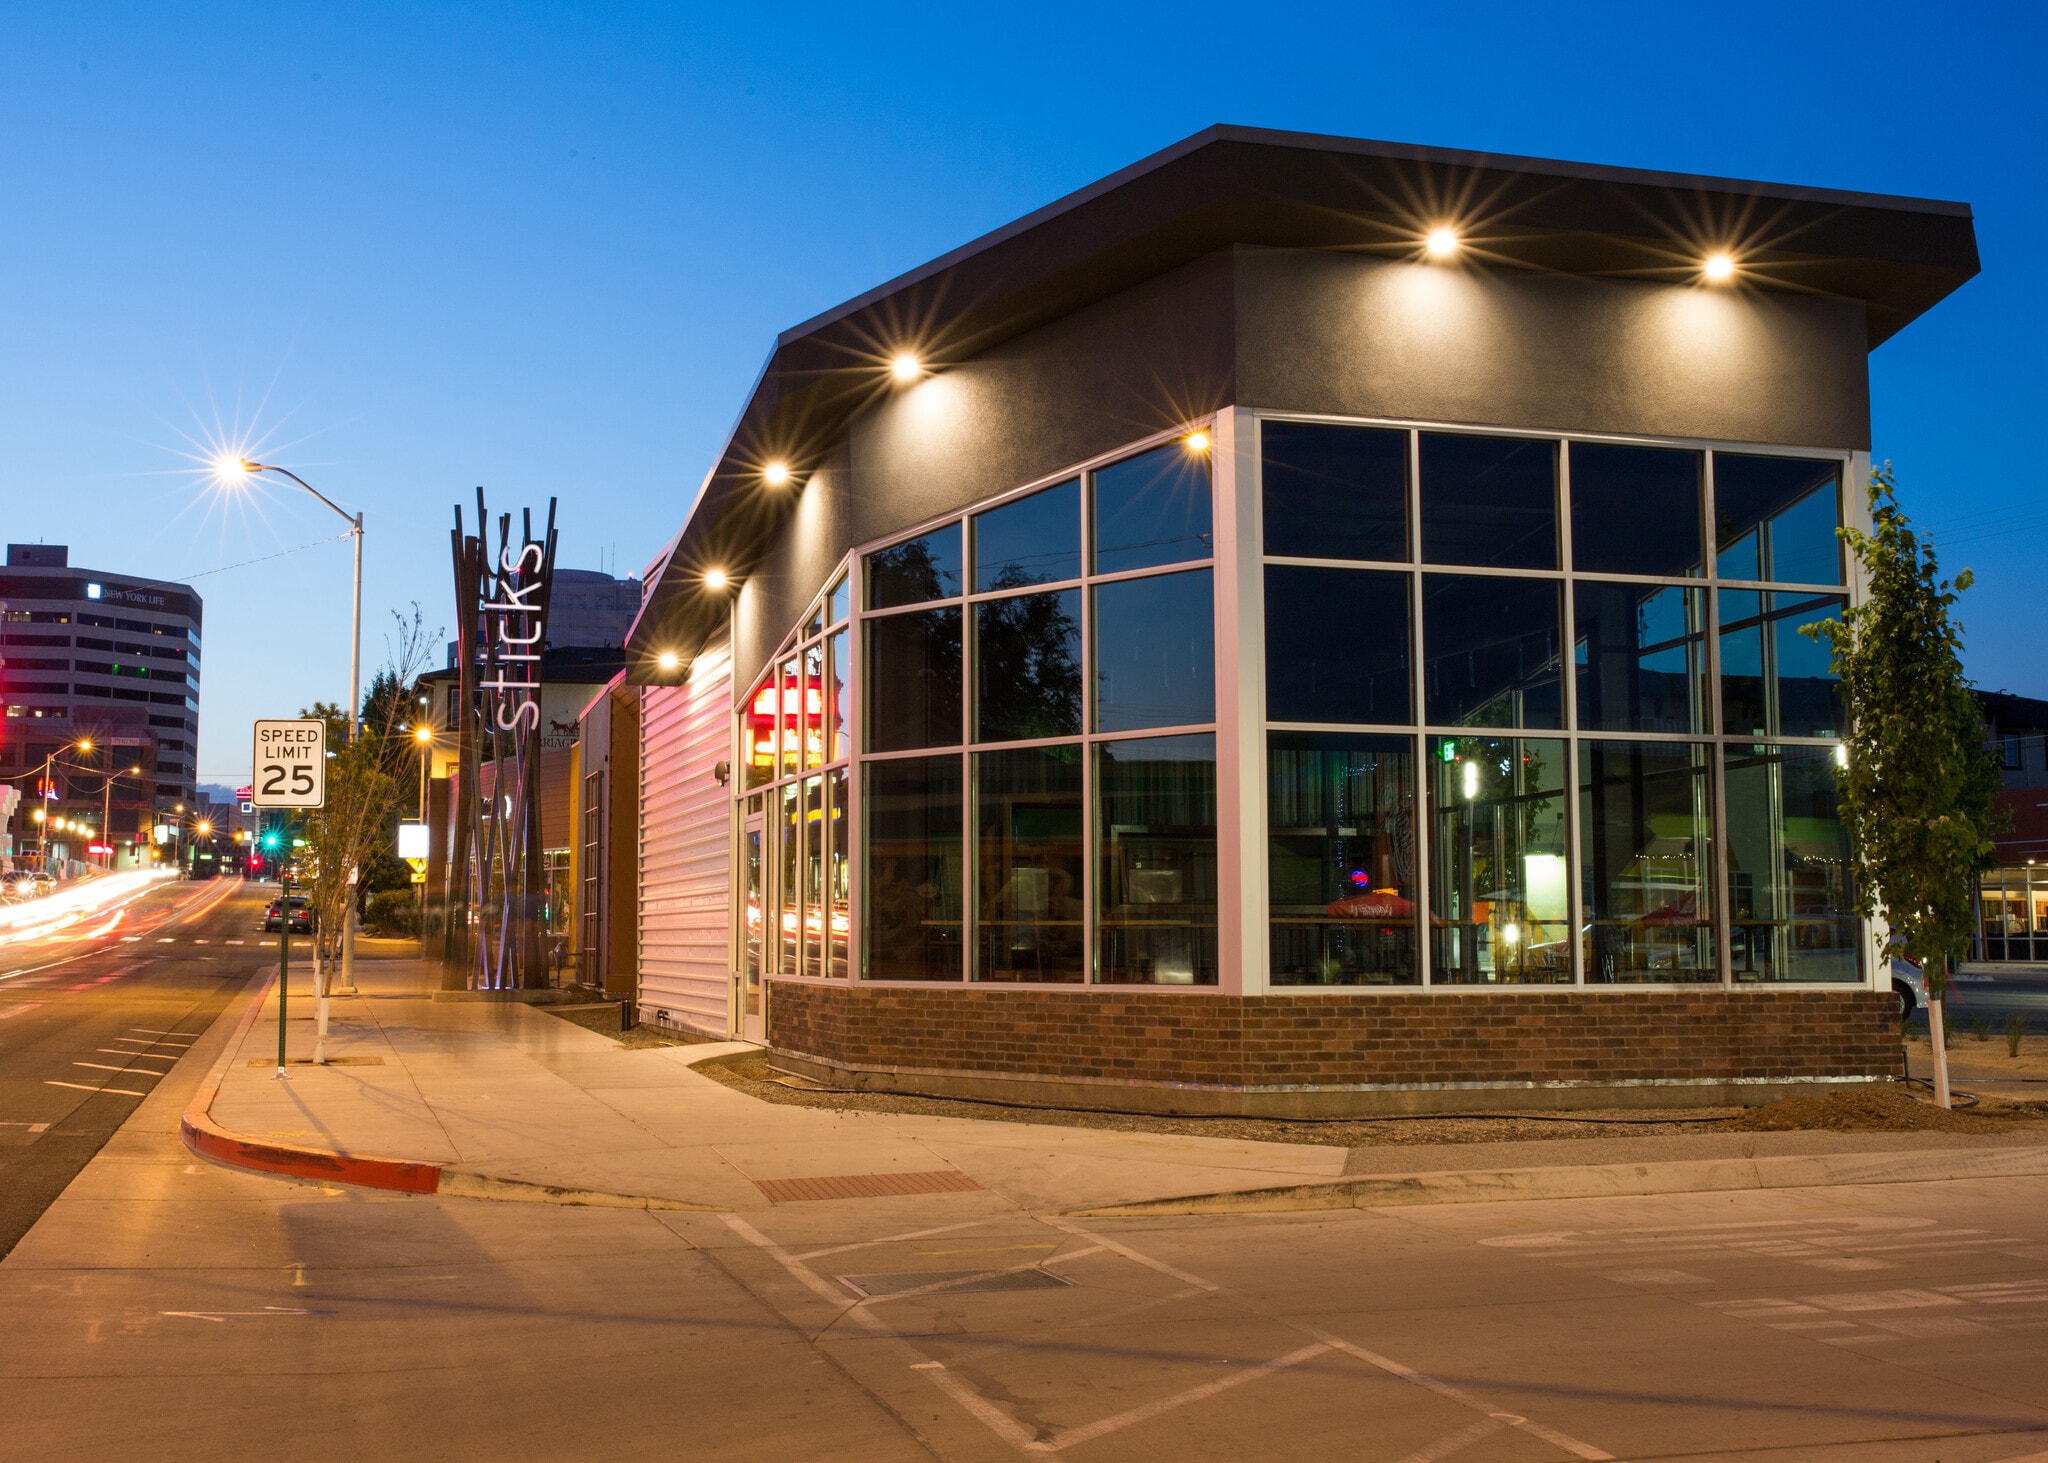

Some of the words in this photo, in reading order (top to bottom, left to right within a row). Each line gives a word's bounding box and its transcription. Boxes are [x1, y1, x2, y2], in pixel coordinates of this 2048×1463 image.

[104, 588, 123, 600] NEW
[125, 591, 147, 603] YORK
[148, 595, 165, 606] LIFE
[260, 729, 318, 743] SPEED
[265, 746, 312, 759] LIMIT
[261, 764, 314, 796] 25
